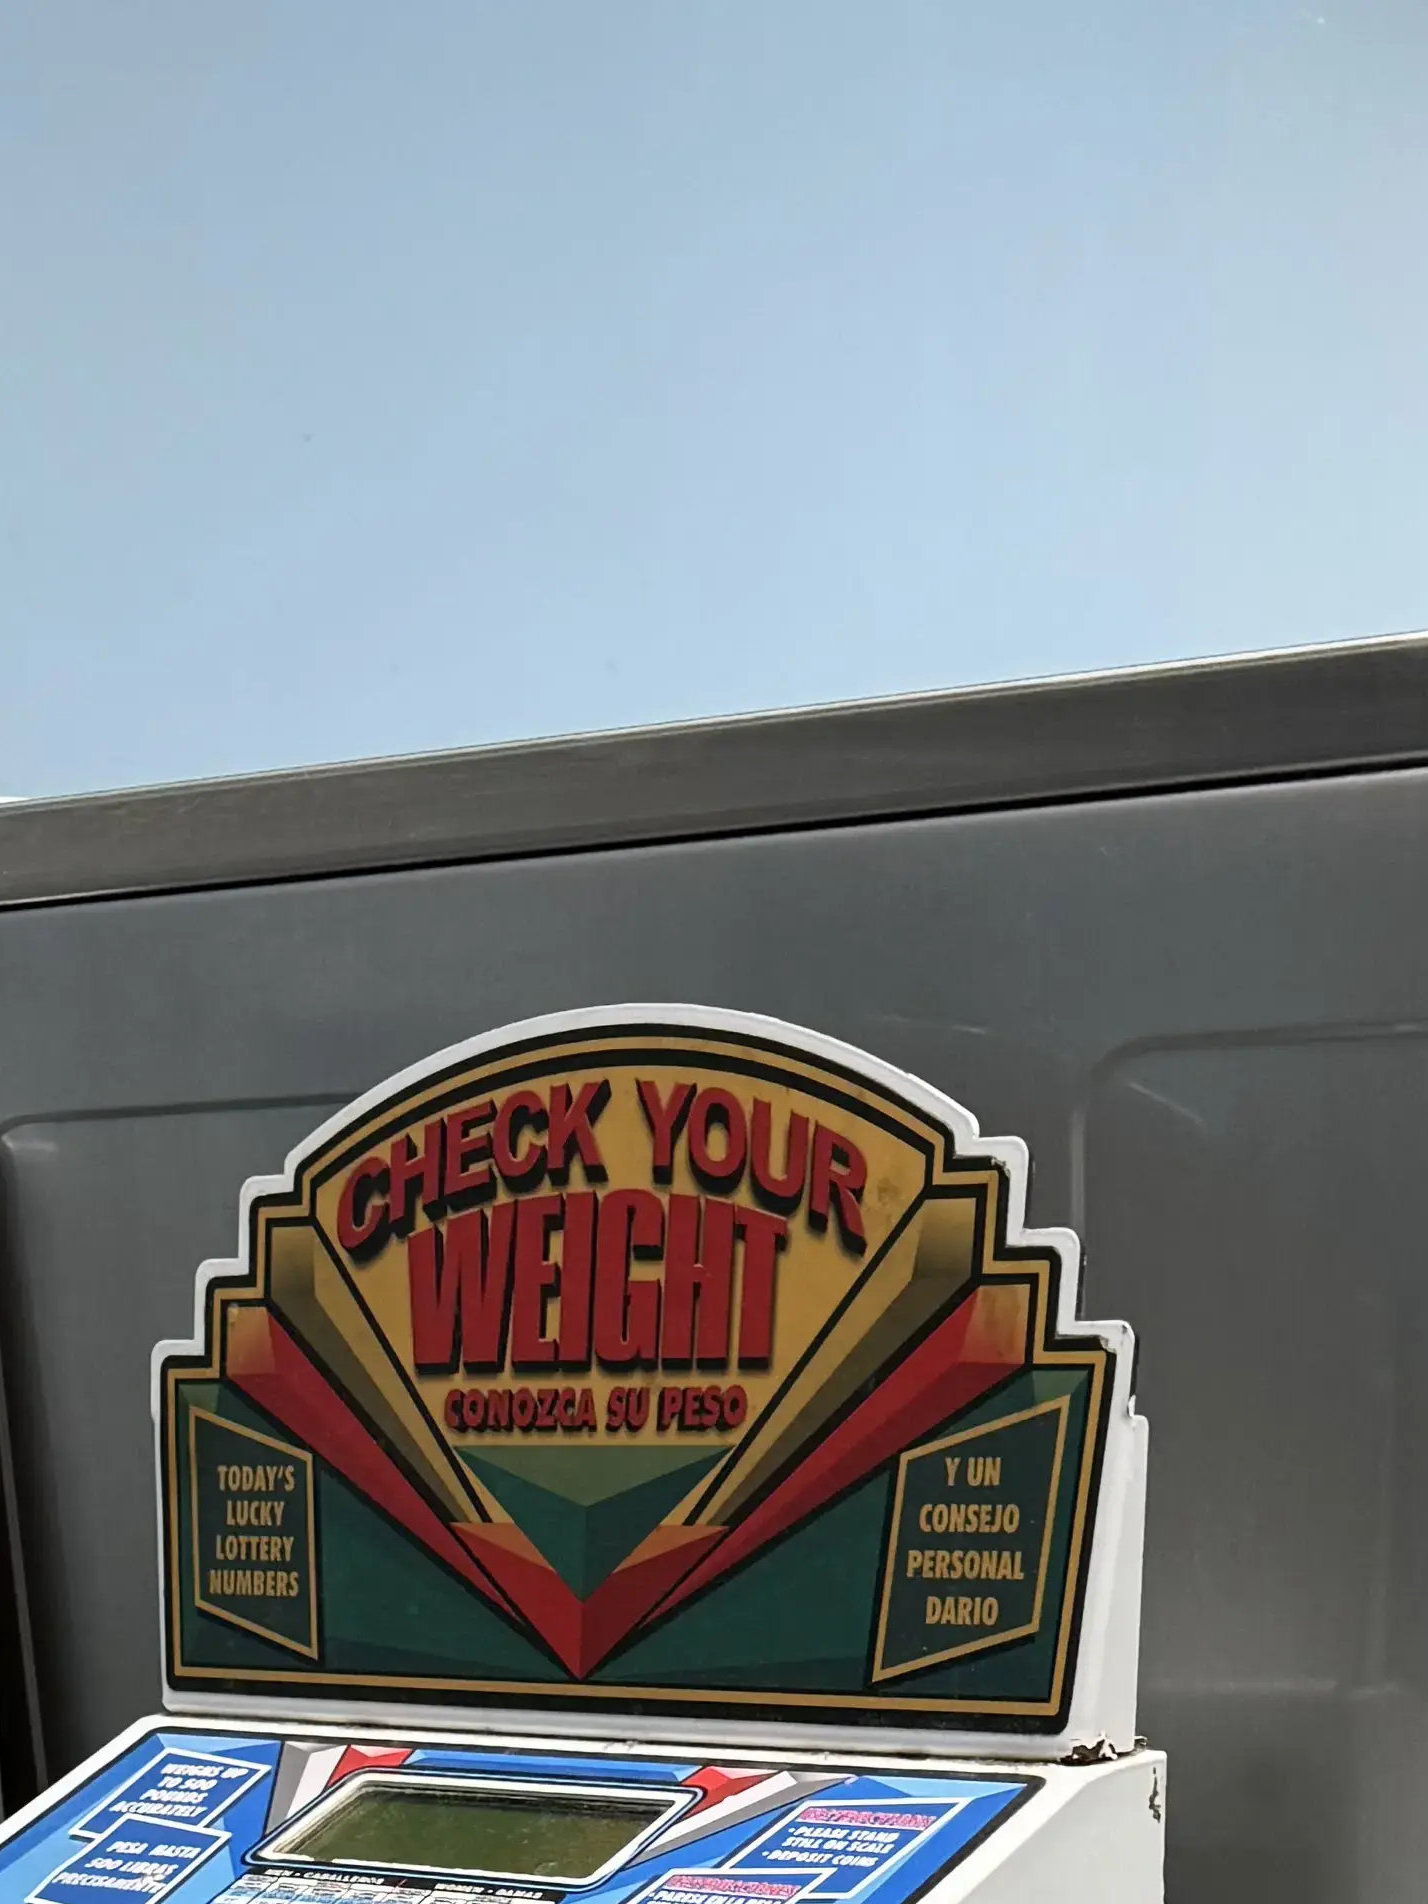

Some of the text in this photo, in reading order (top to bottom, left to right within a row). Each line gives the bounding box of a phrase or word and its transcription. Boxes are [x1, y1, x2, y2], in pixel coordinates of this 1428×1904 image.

[337, 1080, 869, 1258] CHECK YOUR
[406, 1190, 787, 1372] WEIGHT
[444, 1385, 748, 1432] CONOZCA SU PESO
[217, 1465, 295, 1492] TODAY'S
[945, 1456, 1002, 1487] Y UN
[226, 1501, 285, 1527] LUCKY
[919, 1503, 1021, 1534] CONSEJO
[216, 1535, 294, 1562] LOTTERY
[906, 1549, 1025, 1580] PERSONAL
[209, 1569, 299, 1598] NUMBERS
[925, 1596, 1000, 1626] DARIO
[157, 1776, 218, 1791] TO 500
[160, 1763, 249, 1779] WEIGHS UP
[108, 1801, 209, 1818] ACCURATELY
[139, 1789, 209, 1804] POUNDS
[781, 1836, 895, 1854] STILL ON SCALE
[792, 1826, 900, 1843] PLEASE STAND
[105, 1841, 201, 1859] PESA HASTA
[767, 1850, 879, 1867] DEPOSIT COINS
[84, 1857, 180, 1877] 500 LIBRAS
